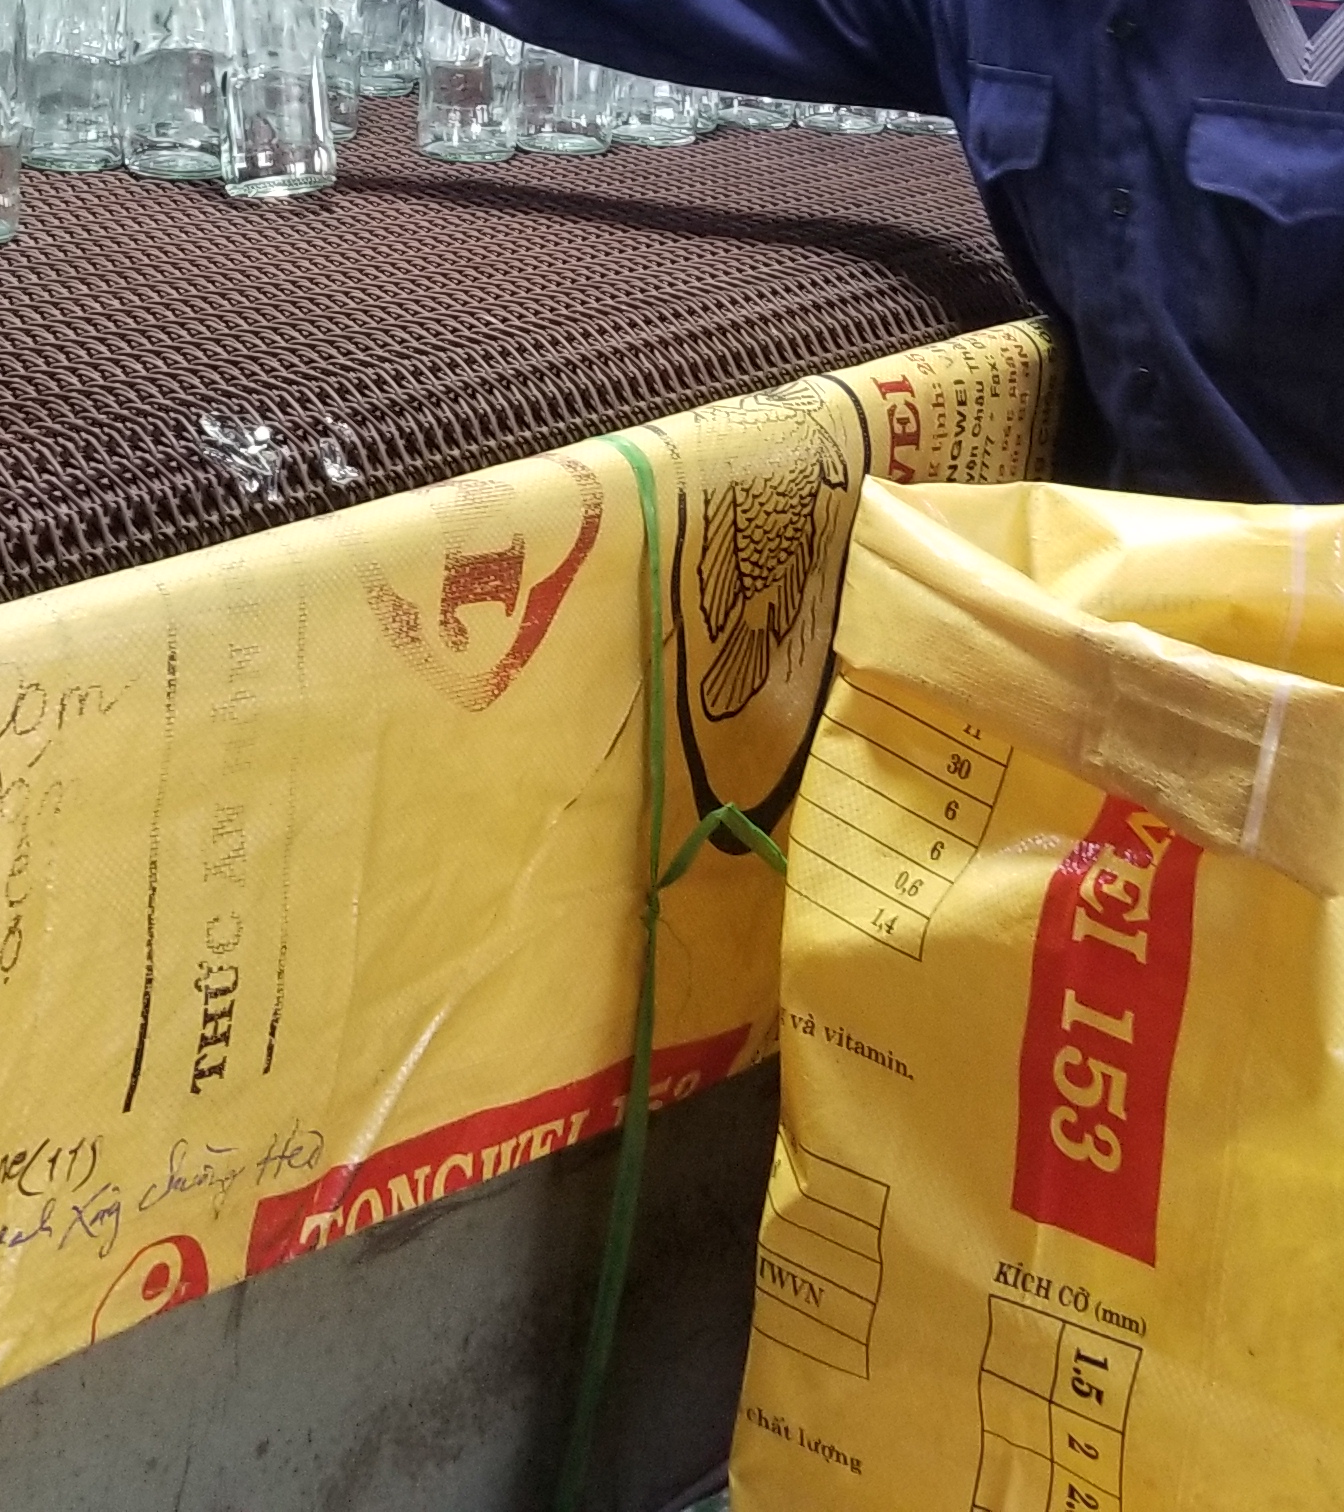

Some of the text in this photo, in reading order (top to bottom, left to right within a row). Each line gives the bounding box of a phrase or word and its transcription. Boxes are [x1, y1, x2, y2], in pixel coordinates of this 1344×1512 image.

[946, 752, 973, 781] 30
[944, 799, 960, 821] 6
[930, 839, 945, 862] 6
[893, 869, 925, 899] 0,6
[869, 906, 900, 936] 1,4
[789, 1012, 915, 1082] và vitamin.
[1050, 987, 1136, 1173] 153
[992, 1260, 1148, 1338] KÍCH CỠ (mm)
[1069, 1345, 1112, 1408] 1.5
[744, 1406, 864, 1476] chất lượng
[1066, 1432, 1101, 1462] 2
[1066, 1481, 1101, 1512] 2.
